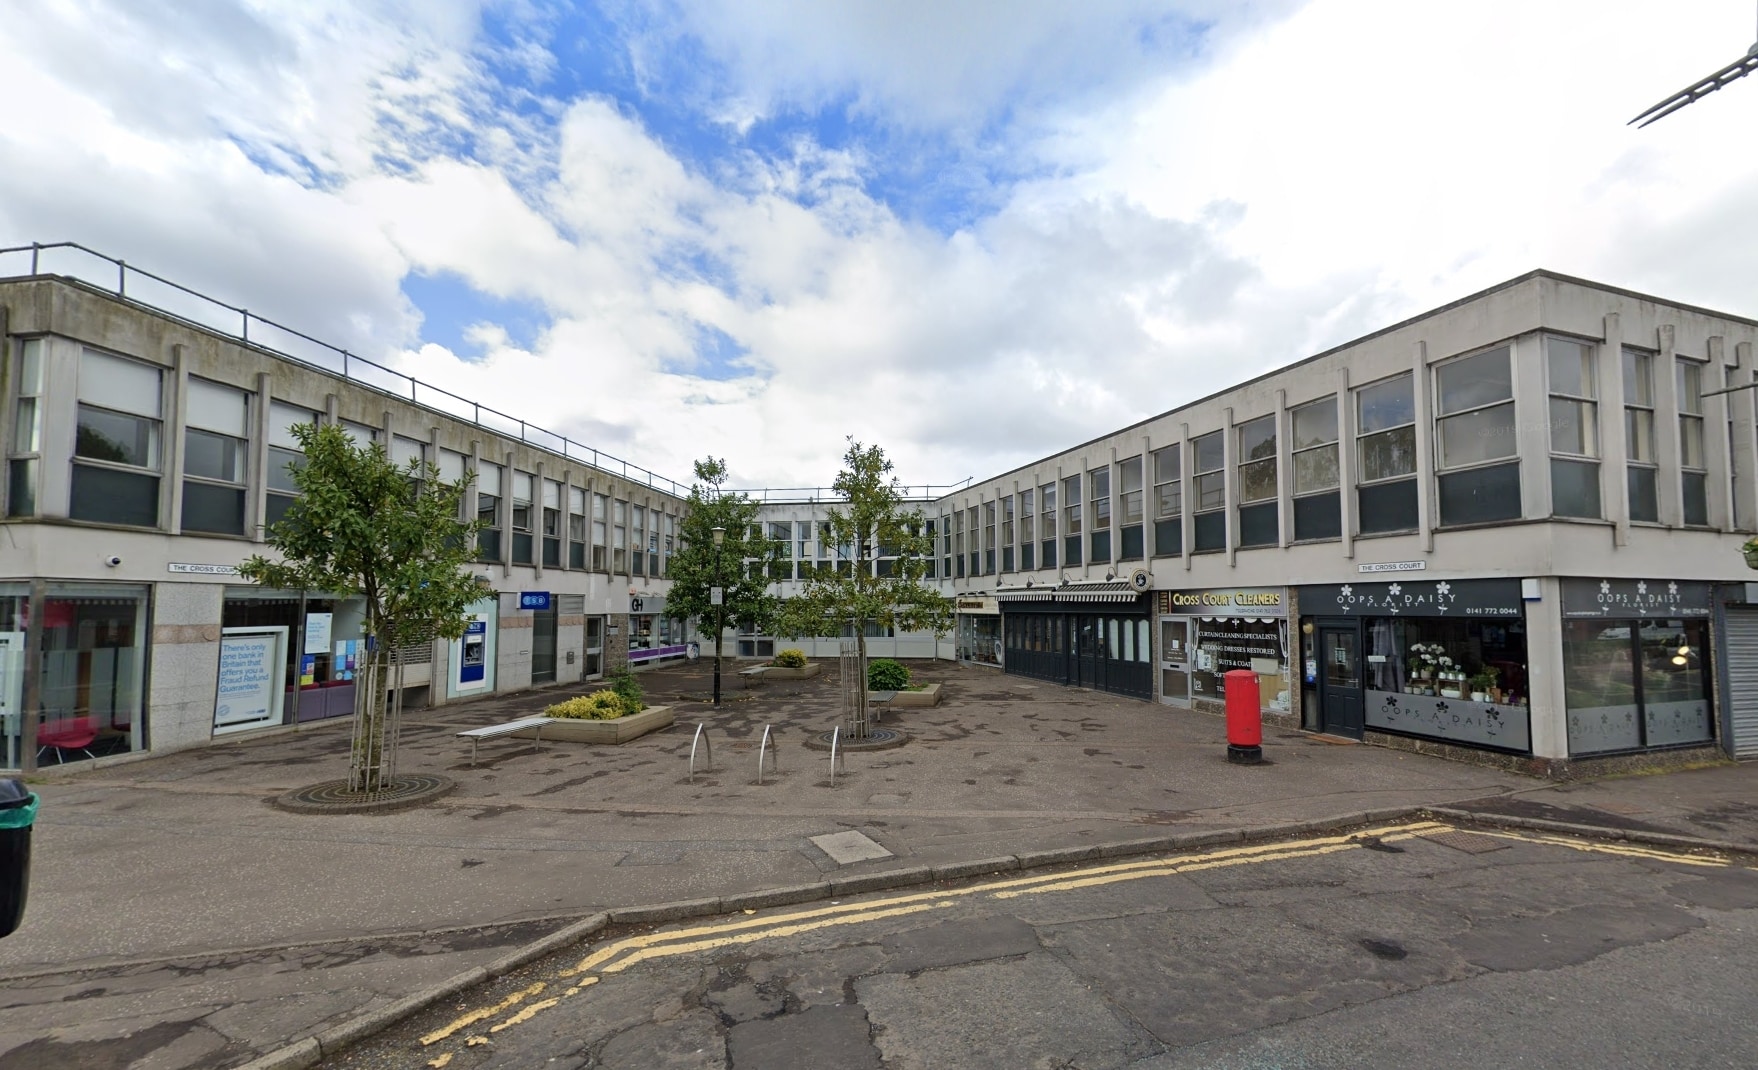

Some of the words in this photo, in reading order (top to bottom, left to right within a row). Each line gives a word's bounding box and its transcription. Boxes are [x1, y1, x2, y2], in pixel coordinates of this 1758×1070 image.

[1173, 593, 1200, 605] CROSS
[1202, 593, 1231, 606] COURT
[1234, 592, 1280, 606] CLEANERS
[1337, 595, 1374, 603] OOPS
[1404, 594, 1456, 603] DAISY
[1597, 594, 1628, 603] OOPS
[1635, 594, 1642, 602] A
[1649, 594, 1681, 603] DAISY
[220, 677, 243, 685] Fraud
[244, 673, 269, 682] Refund
[1381, 706, 1420, 717] OOPS
[1452, 714, 1504, 728] DAISY
